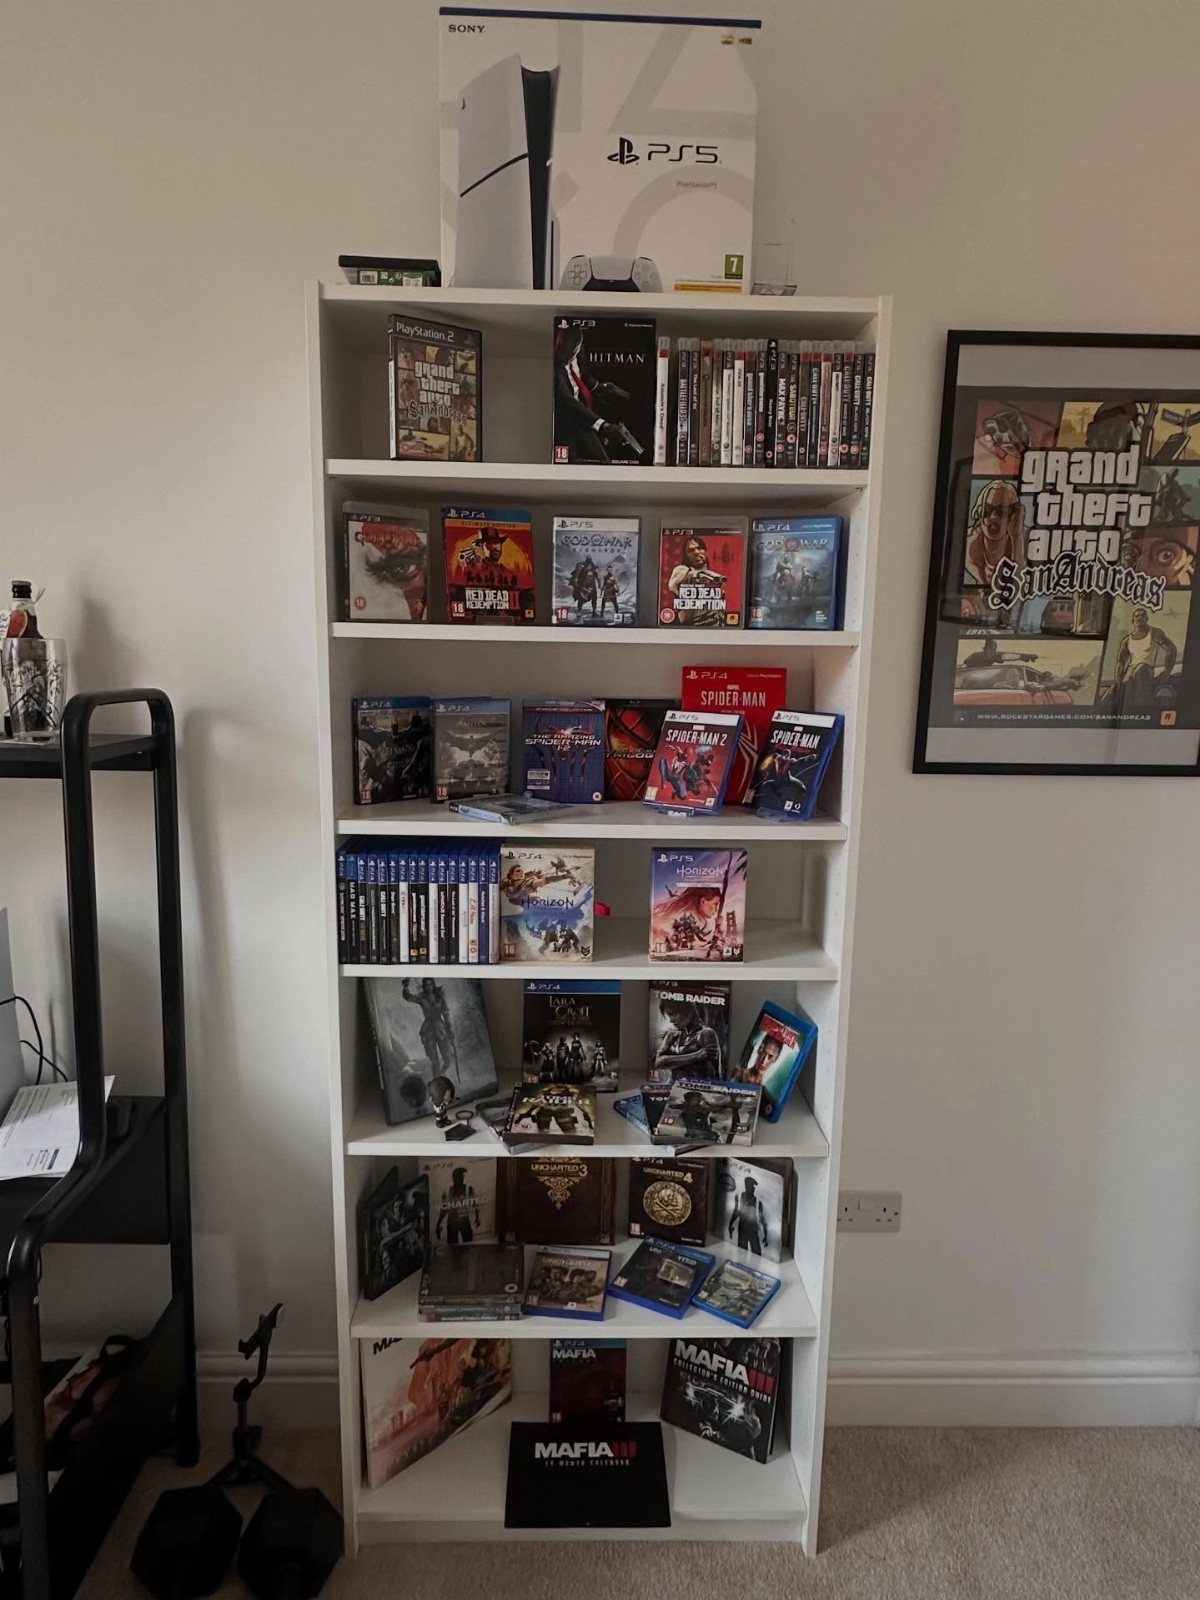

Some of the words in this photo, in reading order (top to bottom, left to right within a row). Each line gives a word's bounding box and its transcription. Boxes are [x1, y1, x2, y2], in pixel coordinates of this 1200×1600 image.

[447, 24, 486, 34] SONY
[647, 143, 719, 164] PS5
[572, 319, 596, 327] PS3
[396, 322, 445, 341] PlayStation
[447, 330, 454, 343] 2
[589, 352, 646, 363] HITMAN
[414, 360, 454, 380] grand
[421, 376, 460, 396] theft
[778, 378, 786, 396] MAX
[419, 391, 452, 407] auto
[789, 384, 797, 420] SABOTEUR
[556, 448, 568, 458] 18
[1021, 445, 1139, 492] grand
[1036, 484, 1152, 527] theft
[460, 511, 485, 519] PS4
[767, 523, 790, 531] PS4
[1027, 529, 1121, 562] auto
[465, 589, 483, 601] RED
[485, 590, 509, 602] DEAD
[679, 588, 697, 599] RED
[697, 588, 722, 599] DEAD
[453, 603, 464, 613] 18
[466, 601, 509, 610] REDEMPTION
[673, 599, 727, 610] REDEMPTION
[557, 609, 568, 619] 18
[752, 608, 762, 618] 18
[701, 671, 728, 679] PS4
[701, 690, 766, 707] SPIDER-MAN
[666, 729, 720, 746] SPIDER-MAN
[719, 733, 728, 746] 2
[770, 730, 821, 749] SPIDER-MAN
[676, 864, 724, 878] HORIZON
[522, 896, 575, 910] HORIZON
[654, 990, 685, 1001] TOMB
[685, 993, 726, 1006] RAIDER
[531, 1163, 578, 1171] UNCHARTED
[578, 1164, 588, 1177] 3
[643, 1167, 685, 1178] UNCHARTED
[683, 1172, 693, 1183] 4
[552, 1349, 597, 1359] MAFIA
[675, 1339, 750, 1387] MAFIA
[747, 1365, 775, 1396] III
[673, 1357, 718, 1382] COLLECTOR'S
[719, 1376, 748, 1394] EDITION
[534, 1442, 614, 1459] MAFIA
[612, 1440, 637, 1458] III
